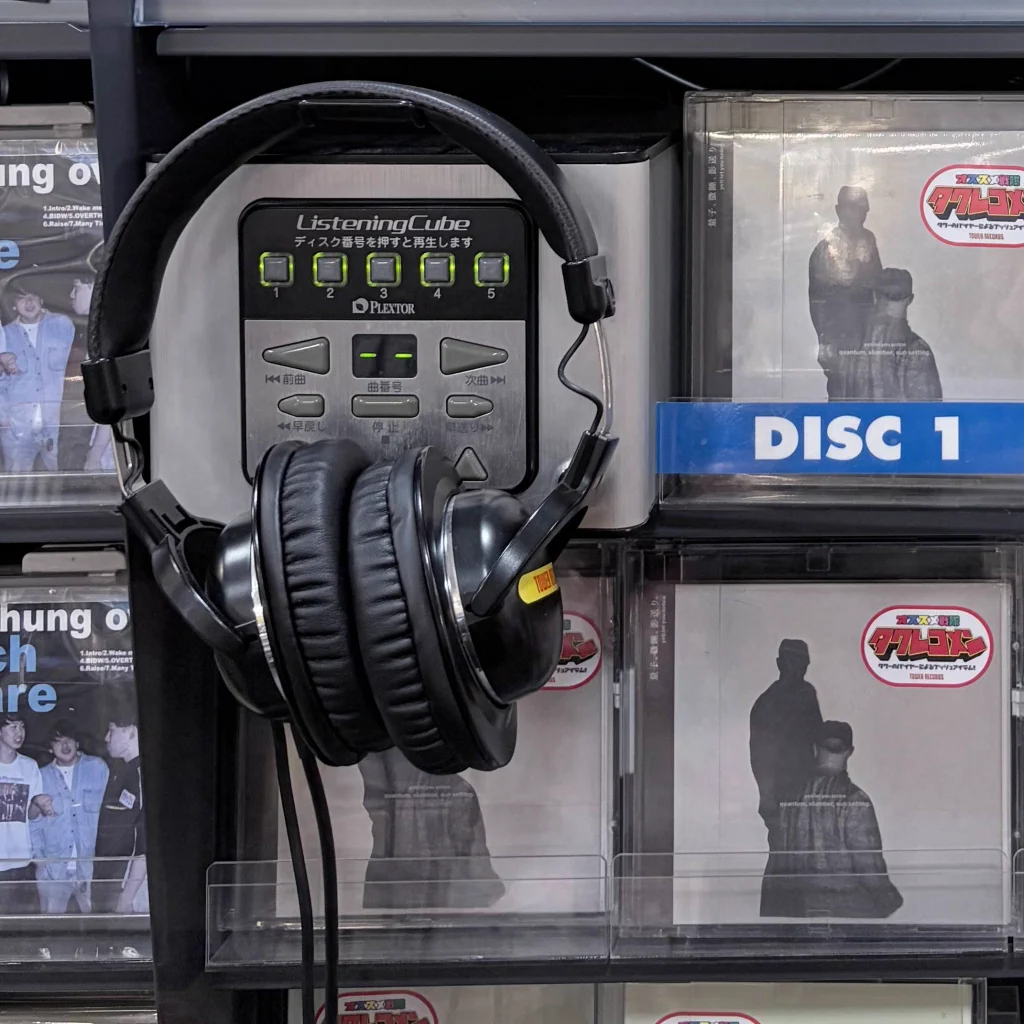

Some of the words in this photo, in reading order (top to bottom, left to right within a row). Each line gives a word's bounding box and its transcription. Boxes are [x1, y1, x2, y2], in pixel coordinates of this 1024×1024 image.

[0, 163, 54, 195] ng
[296, 215, 471, 235] ListeningCube
[294, 236, 473, 249] ディスク番号を押すと再生します
[273, 288, 279, 298] 1
[326, 288, 334, 299] 2
[379, 288, 388, 299] 3
[433, 288, 441, 299] 4
[487, 288, 495, 299] 5
[370, 300, 415, 314] PLEXTOR
[283, 373, 306, 385] 前曲
[367, 381, 403, 393] 曲番号
[465, 374, 489, 386] 次曲
[754, 415, 902, 461] DISC
[934, 416, 959, 460] 1
[105, 608, 130, 631] o
[0, 635, 37, 673] h
[0, 684, 57, 713] re
